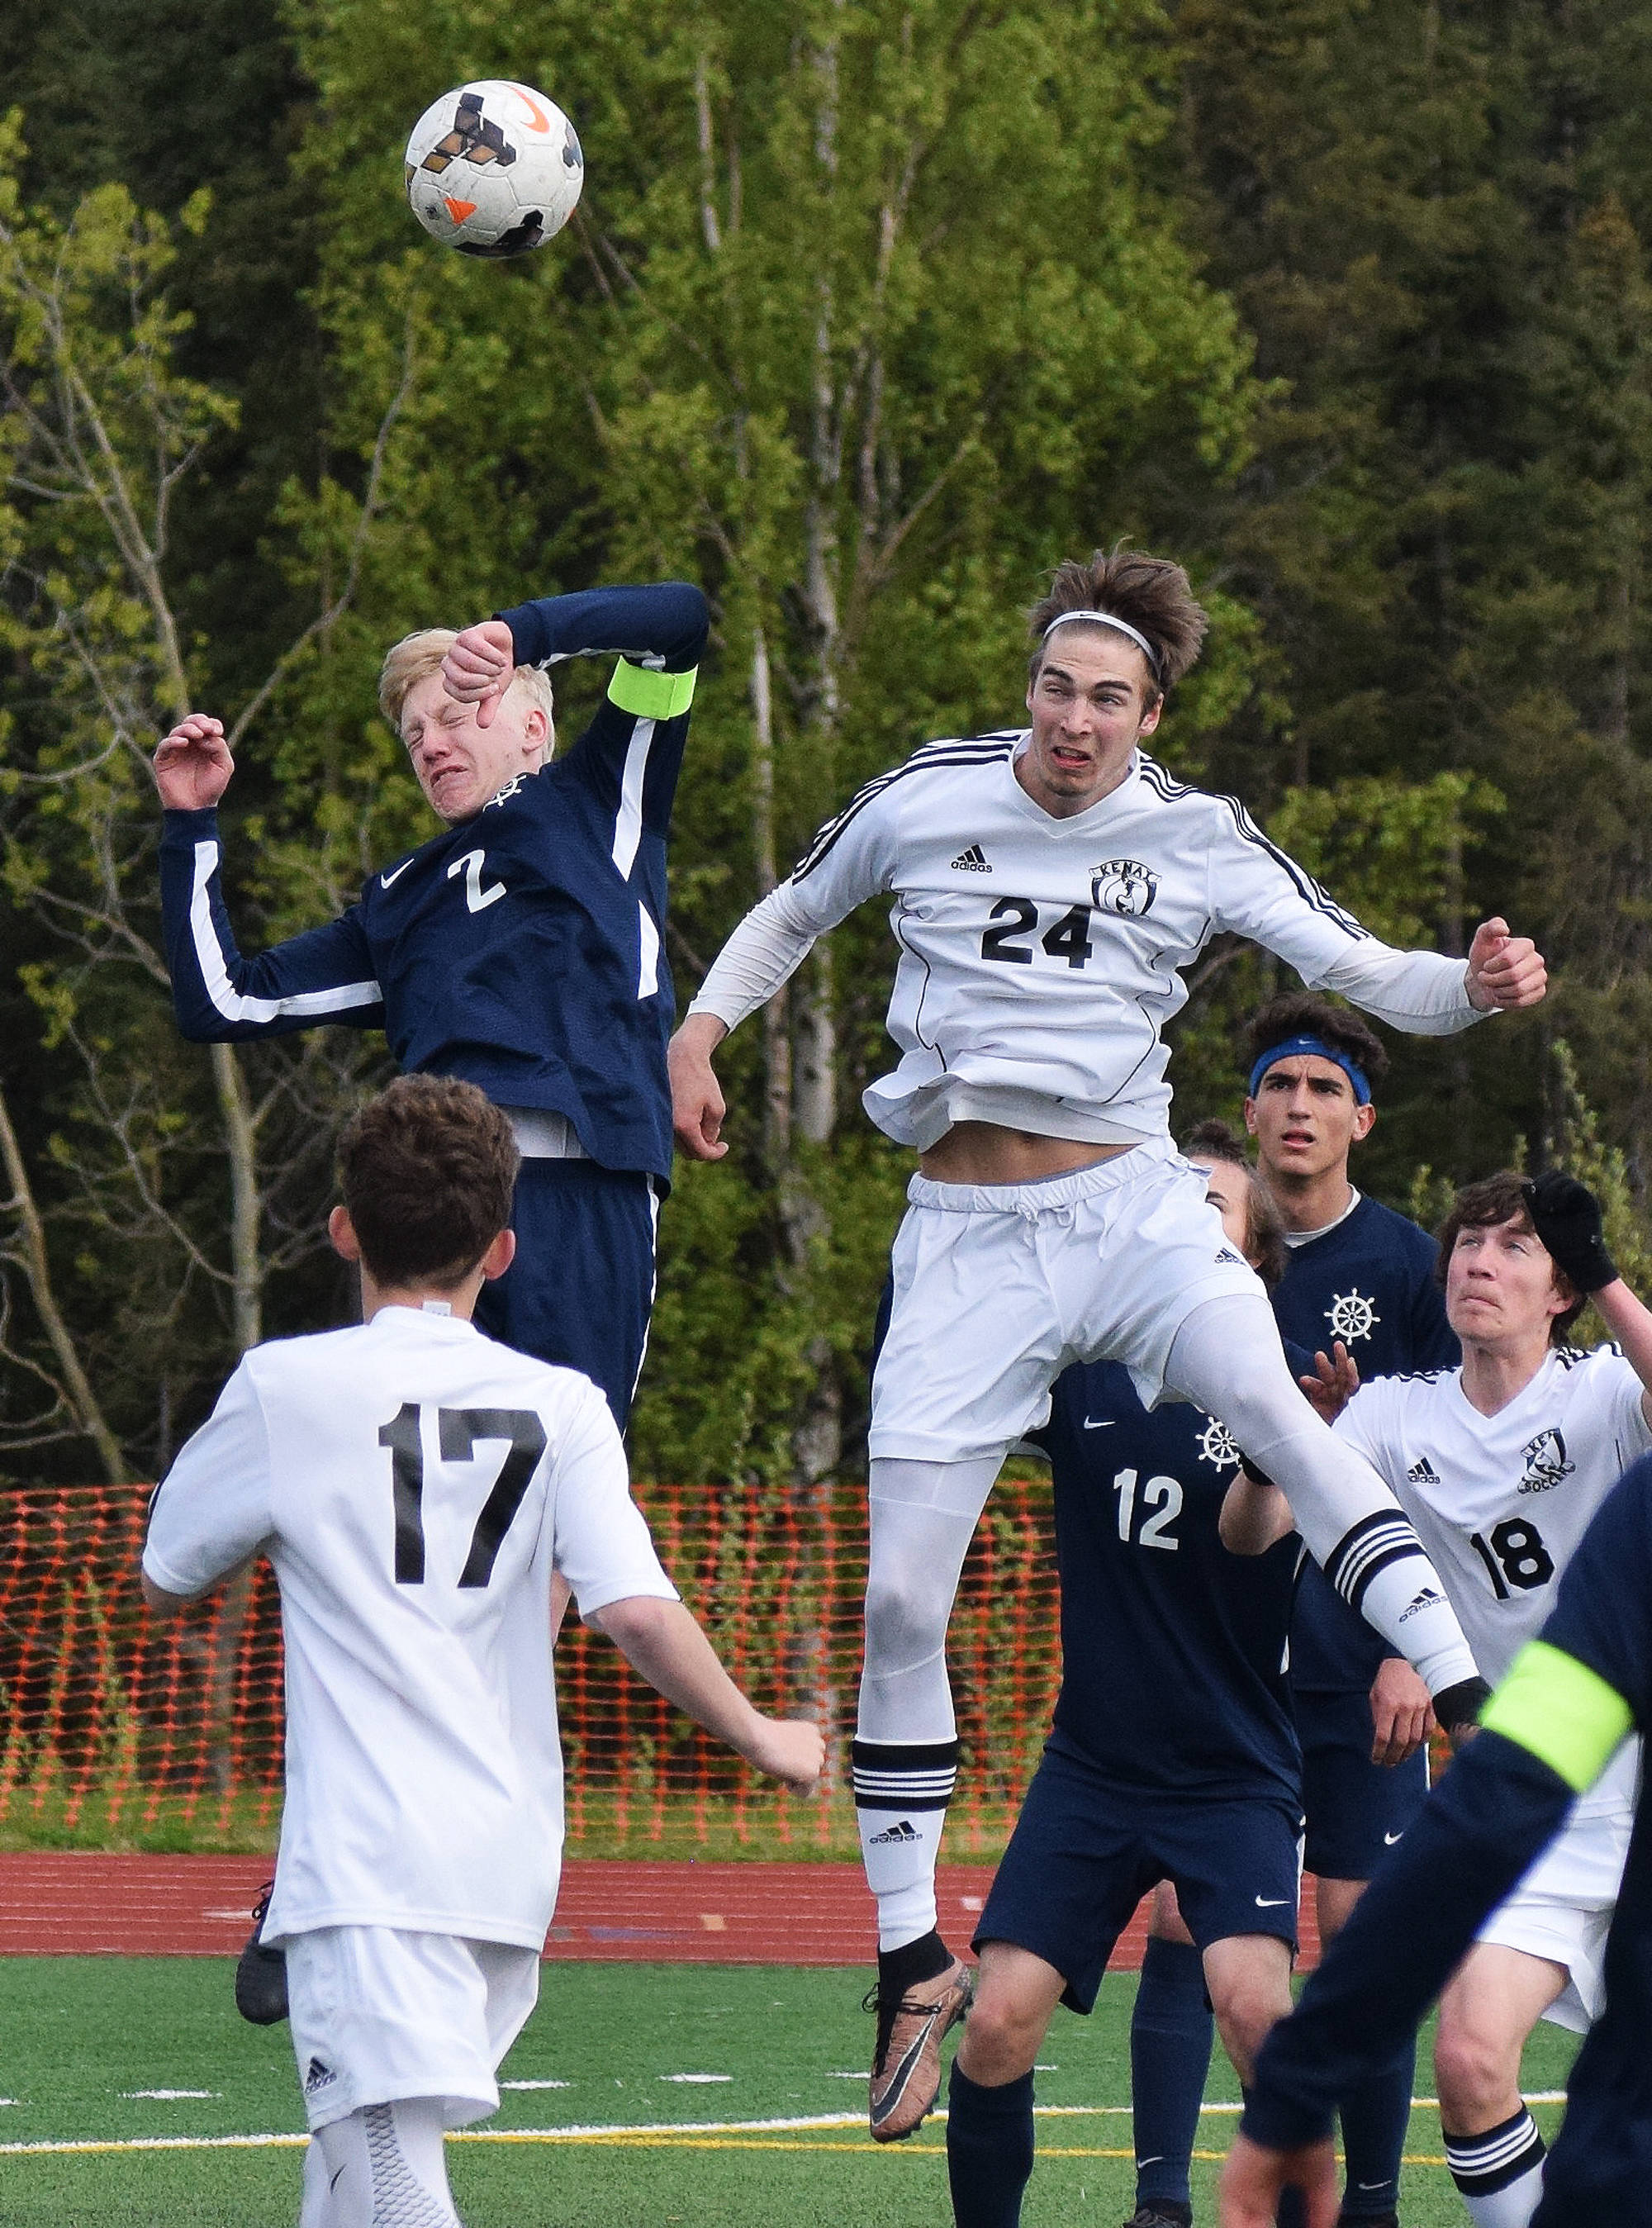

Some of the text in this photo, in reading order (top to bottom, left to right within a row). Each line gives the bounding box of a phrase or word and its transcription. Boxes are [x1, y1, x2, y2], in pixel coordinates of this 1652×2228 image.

[447, 849, 506, 914] 2
[951, 860, 992, 873] adidas
[1100, 862, 1151, 880] KENAI
[981, 896, 1092, 969] 24
[378, 1403, 548, 1588] 17
[1113, 1468, 1183, 1551] 12
[1470, 1518, 1555, 1599] 18
[1398, 1594, 1448, 1623] adidas
[869, 1833, 923, 1844] adidas
